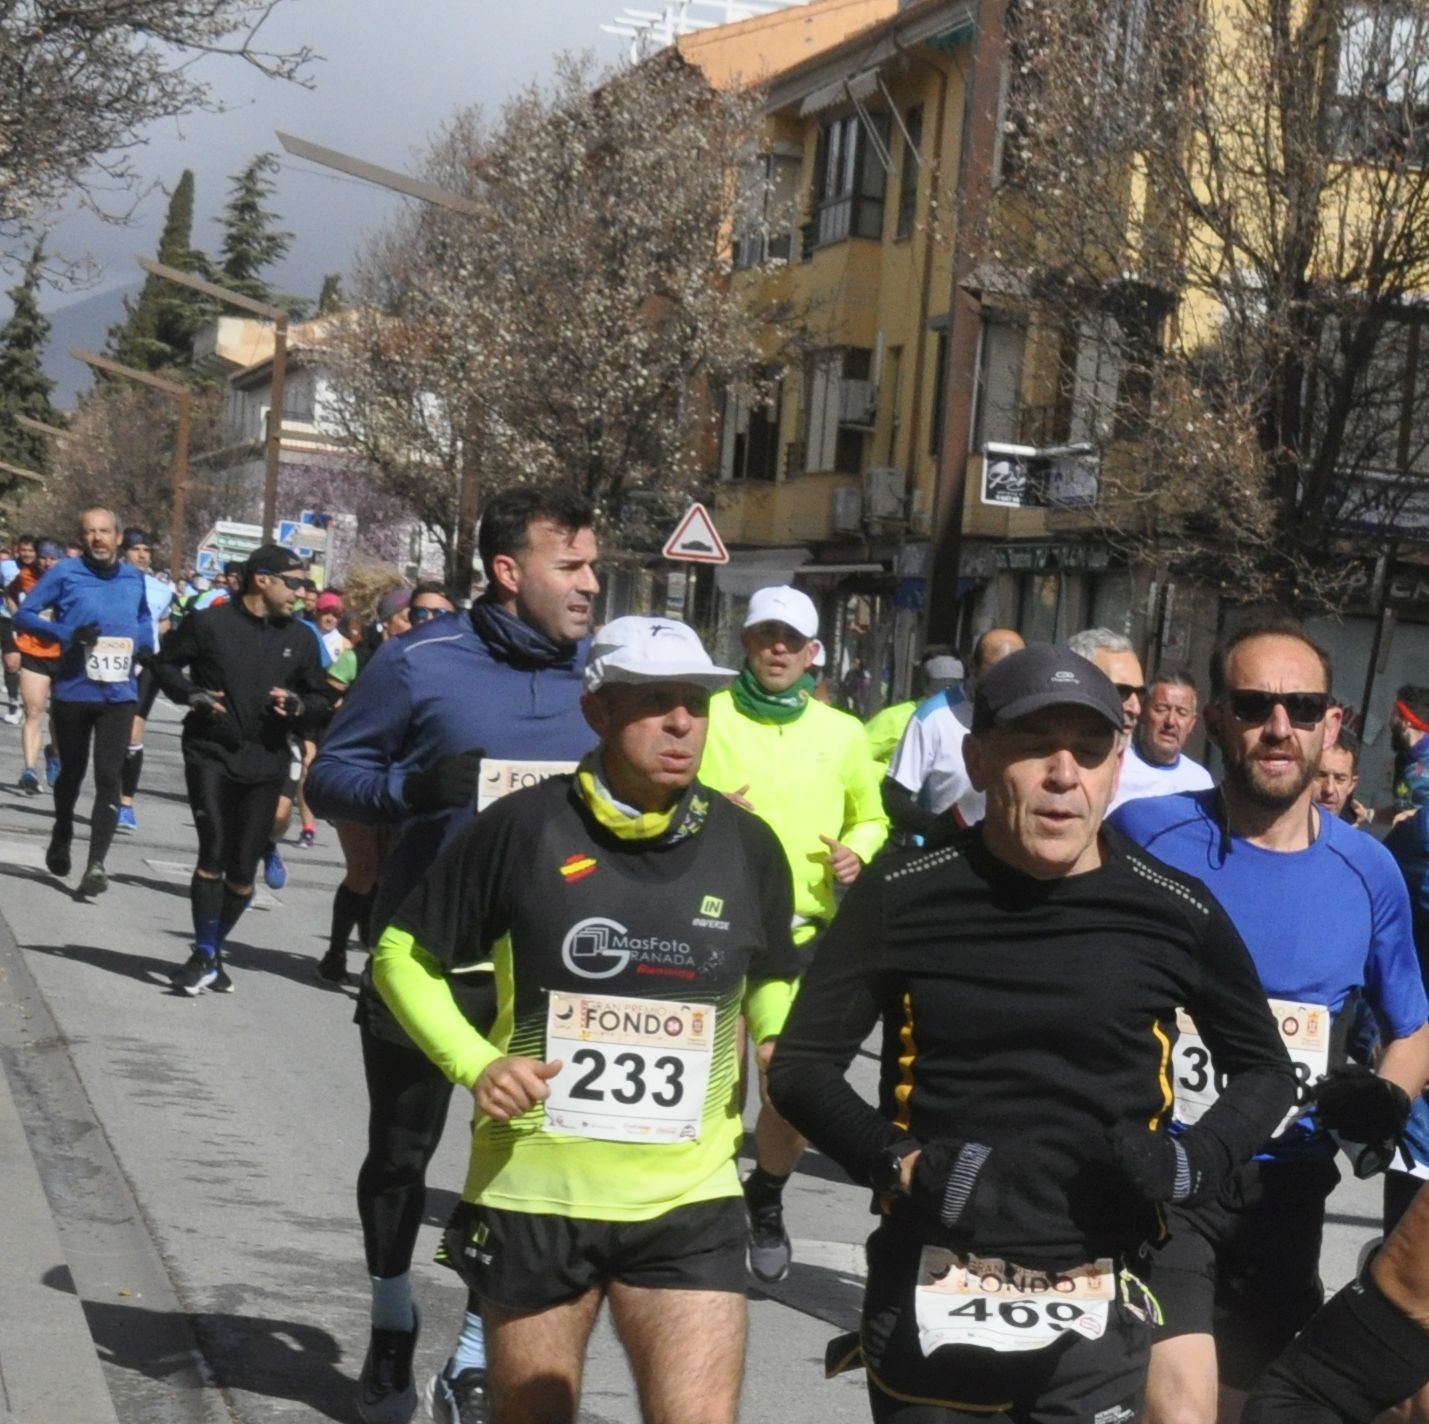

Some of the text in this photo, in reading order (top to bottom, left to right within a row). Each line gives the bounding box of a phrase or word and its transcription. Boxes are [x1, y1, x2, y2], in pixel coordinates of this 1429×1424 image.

[89, 654, 129, 671] 3158
[612, 935, 690, 954] MasFoto
[585, 1007, 684, 1037] FONDO
[568, 1048, 685, 1108] 233
[948, 1297, 1086, 1331] 469
